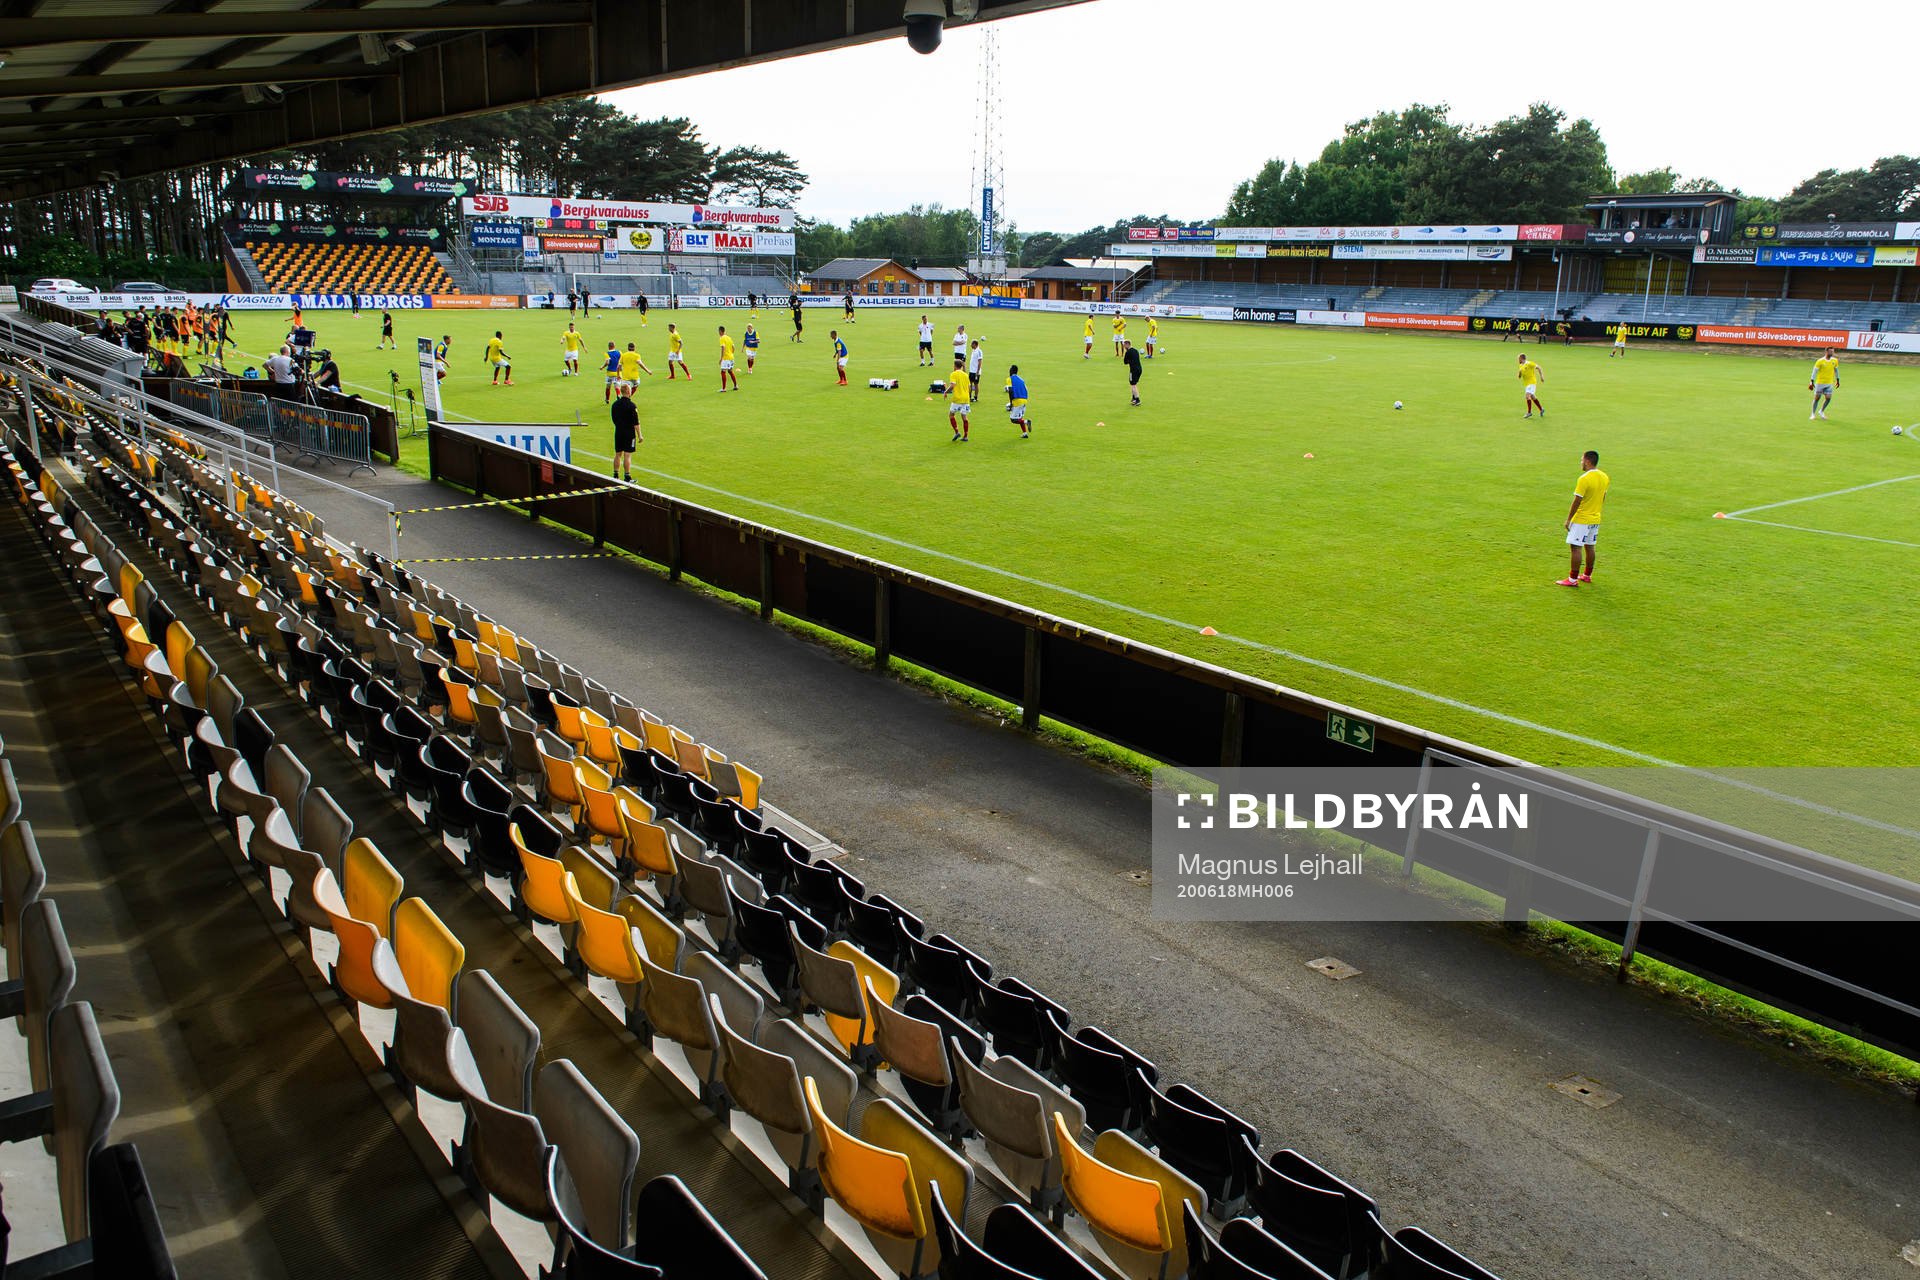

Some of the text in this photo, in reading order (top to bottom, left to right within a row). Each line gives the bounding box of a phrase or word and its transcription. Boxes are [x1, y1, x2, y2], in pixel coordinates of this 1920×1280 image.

[563, 204, 649, 219] Bergkvarabuss
[704, 210, 780, 224] Bergkvarabuss
[473, 225, 495, 234] STÅL
[503, 226, 521, 235] RÖR
[1350, 229, 1387, 237] SÖLVESBORG
[1846, 230, 1890, 238] BROMÖLLA
[477, 236, 518, 244] MONTAGE
[686, 234, 708, 245] BLT
[757, 235, 793, 246] PreFast
[1267, 245, 1290, 257] Sweden
[1775, 251, 1796, 261] Mias
[1821, 251, 1828, 260] &
[219, 294, 285, 308] K-VAGNEN
[300, 294, 424, 309] MALMBERGS
[1250, 308, 1276, 321] home
[1406, 317, 1439, 326] Sölvesborgs
[1439, 319, 1465, 327] kommun
[1651, 327, 1669, 337] AIF
[1700, 329, 1844, 343] Välkommen till Sölvesborgs kommun
[1875, 341, 1900, 350] Group
